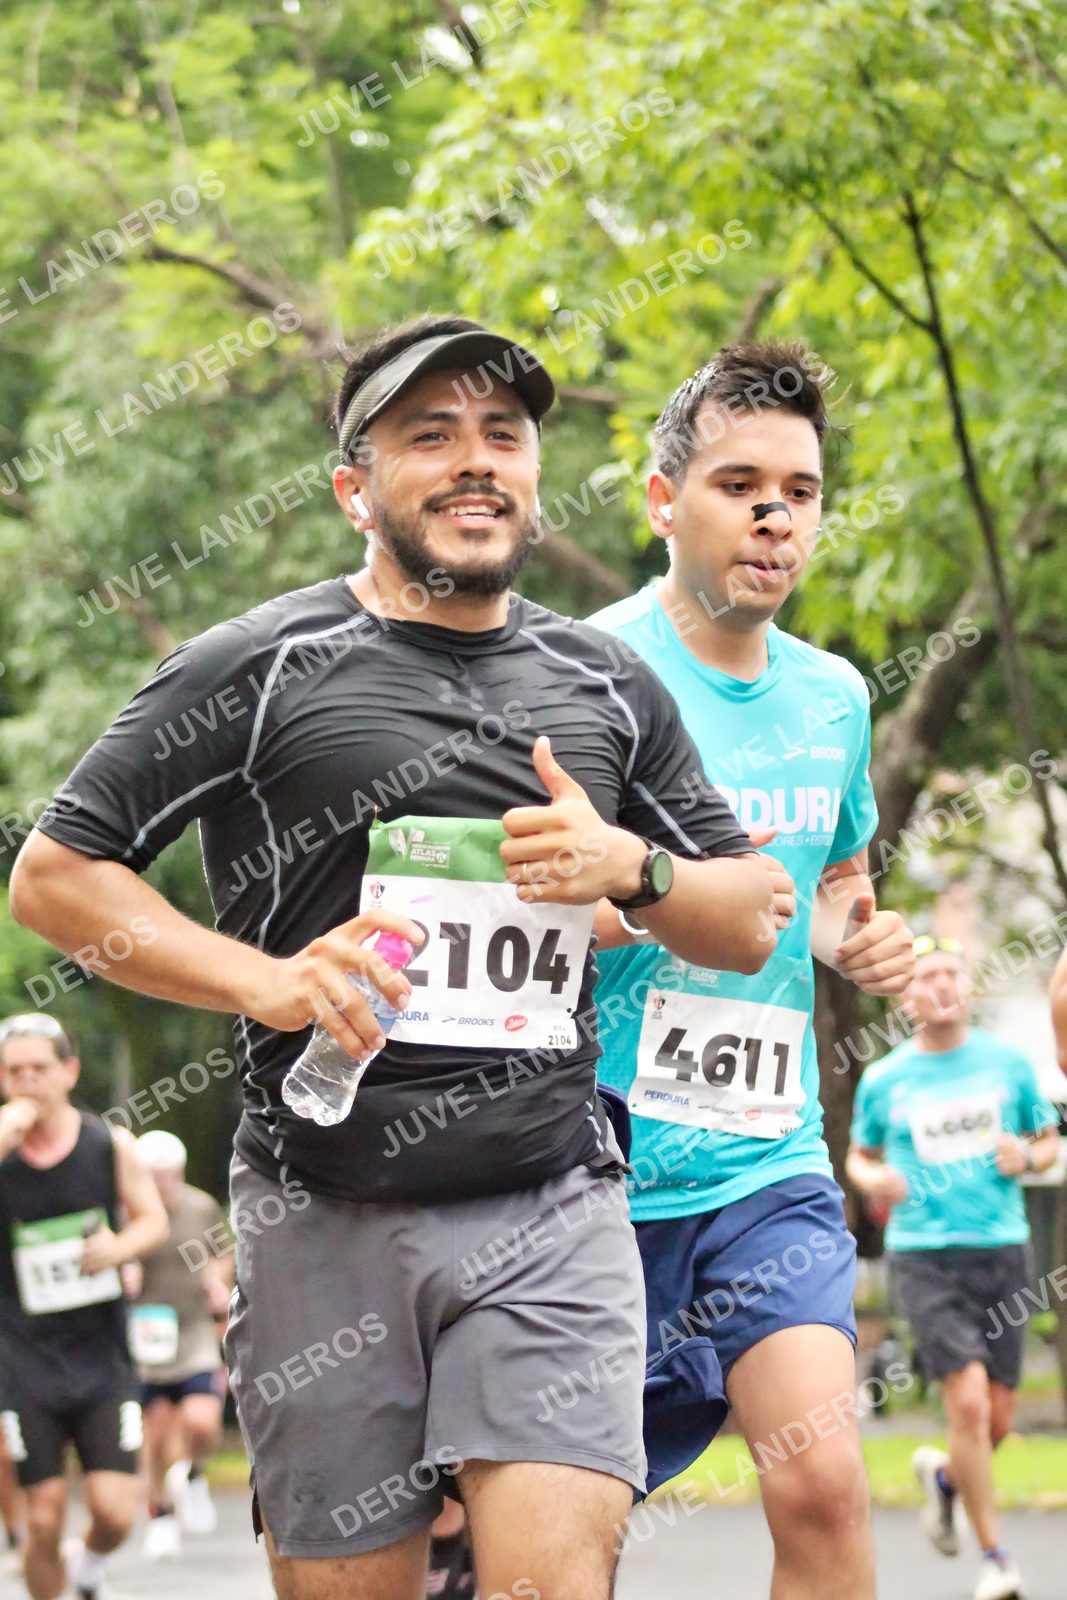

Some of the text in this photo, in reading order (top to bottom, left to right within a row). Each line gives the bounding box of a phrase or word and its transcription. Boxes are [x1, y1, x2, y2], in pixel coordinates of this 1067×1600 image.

[404, 918, 570, 994] 2104
[399, 1010, 430, 1022] DURA
[458, 1016, 495, 1027] BROOKS
[548, 1034, 572, 1046] 2104
[654, 1027, 790, 1096] 4611
[644, 1090, 690, 1106] PERDURA
